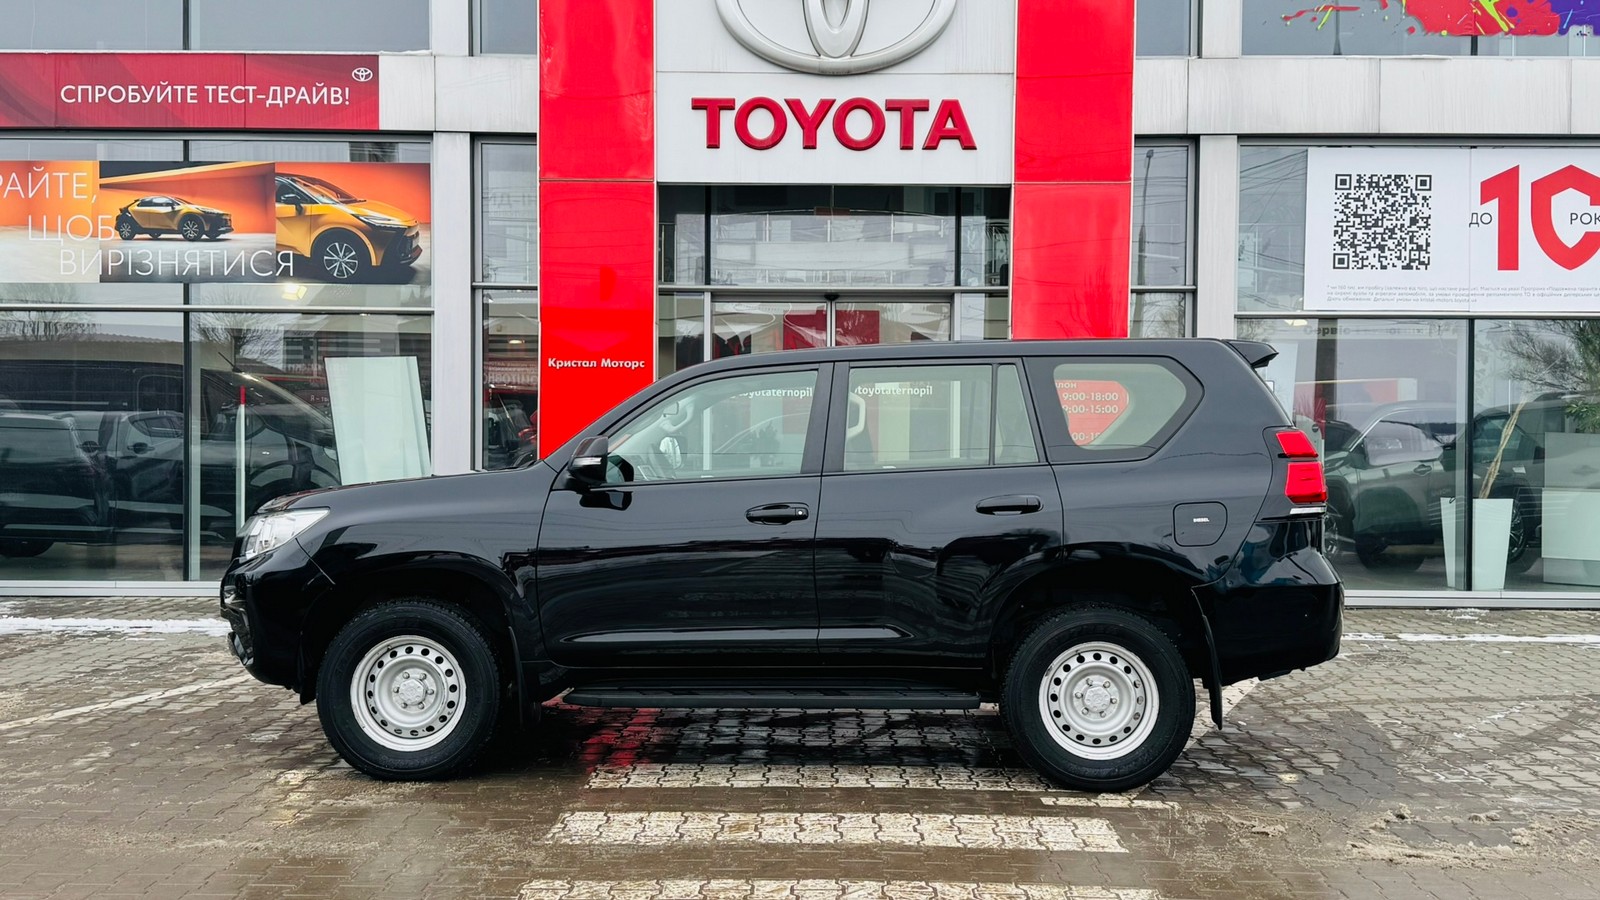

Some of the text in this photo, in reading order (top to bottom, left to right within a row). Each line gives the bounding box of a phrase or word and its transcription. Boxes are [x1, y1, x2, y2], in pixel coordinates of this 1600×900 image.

[60, 81, 350, 107] СПРОБУЙТЕ ТЕСТ-ДРАЙВ!
[691, 96, 978, 151] TOYOTA
[0, 166, 97, 204] АЙТЕ,
[28, 214, 116, 246] ЩОБ
[1468, 212, 1493, 228] ДО
[60, 250, 294, 277] ВИРІЗНЯТИСЯ
[548, 358, 597, 369] Кристал
[601, 358, 645, 370] Моторс
[1062, 392, 1118, 401] 9:00-18:00
